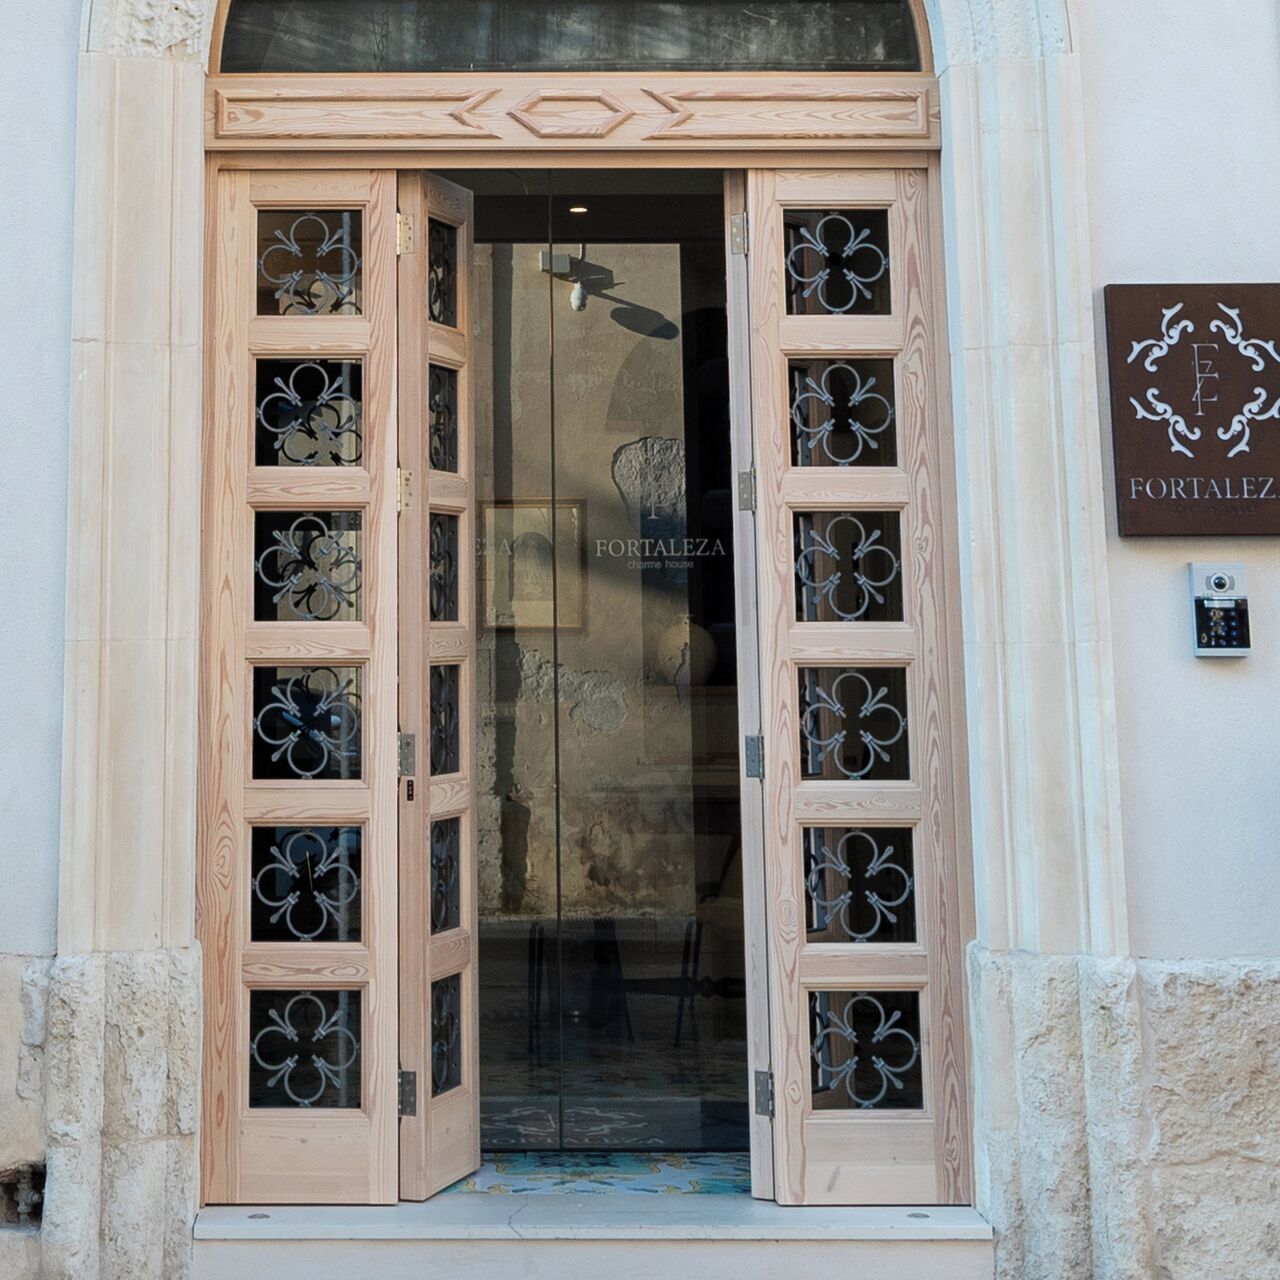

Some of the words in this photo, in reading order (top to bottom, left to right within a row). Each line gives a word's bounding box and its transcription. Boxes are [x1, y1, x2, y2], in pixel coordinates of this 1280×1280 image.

[596, 538, 726, 557] FORTALEZA
[627, 559, 662, 569] charme
[665, 559, 694, 569] house
